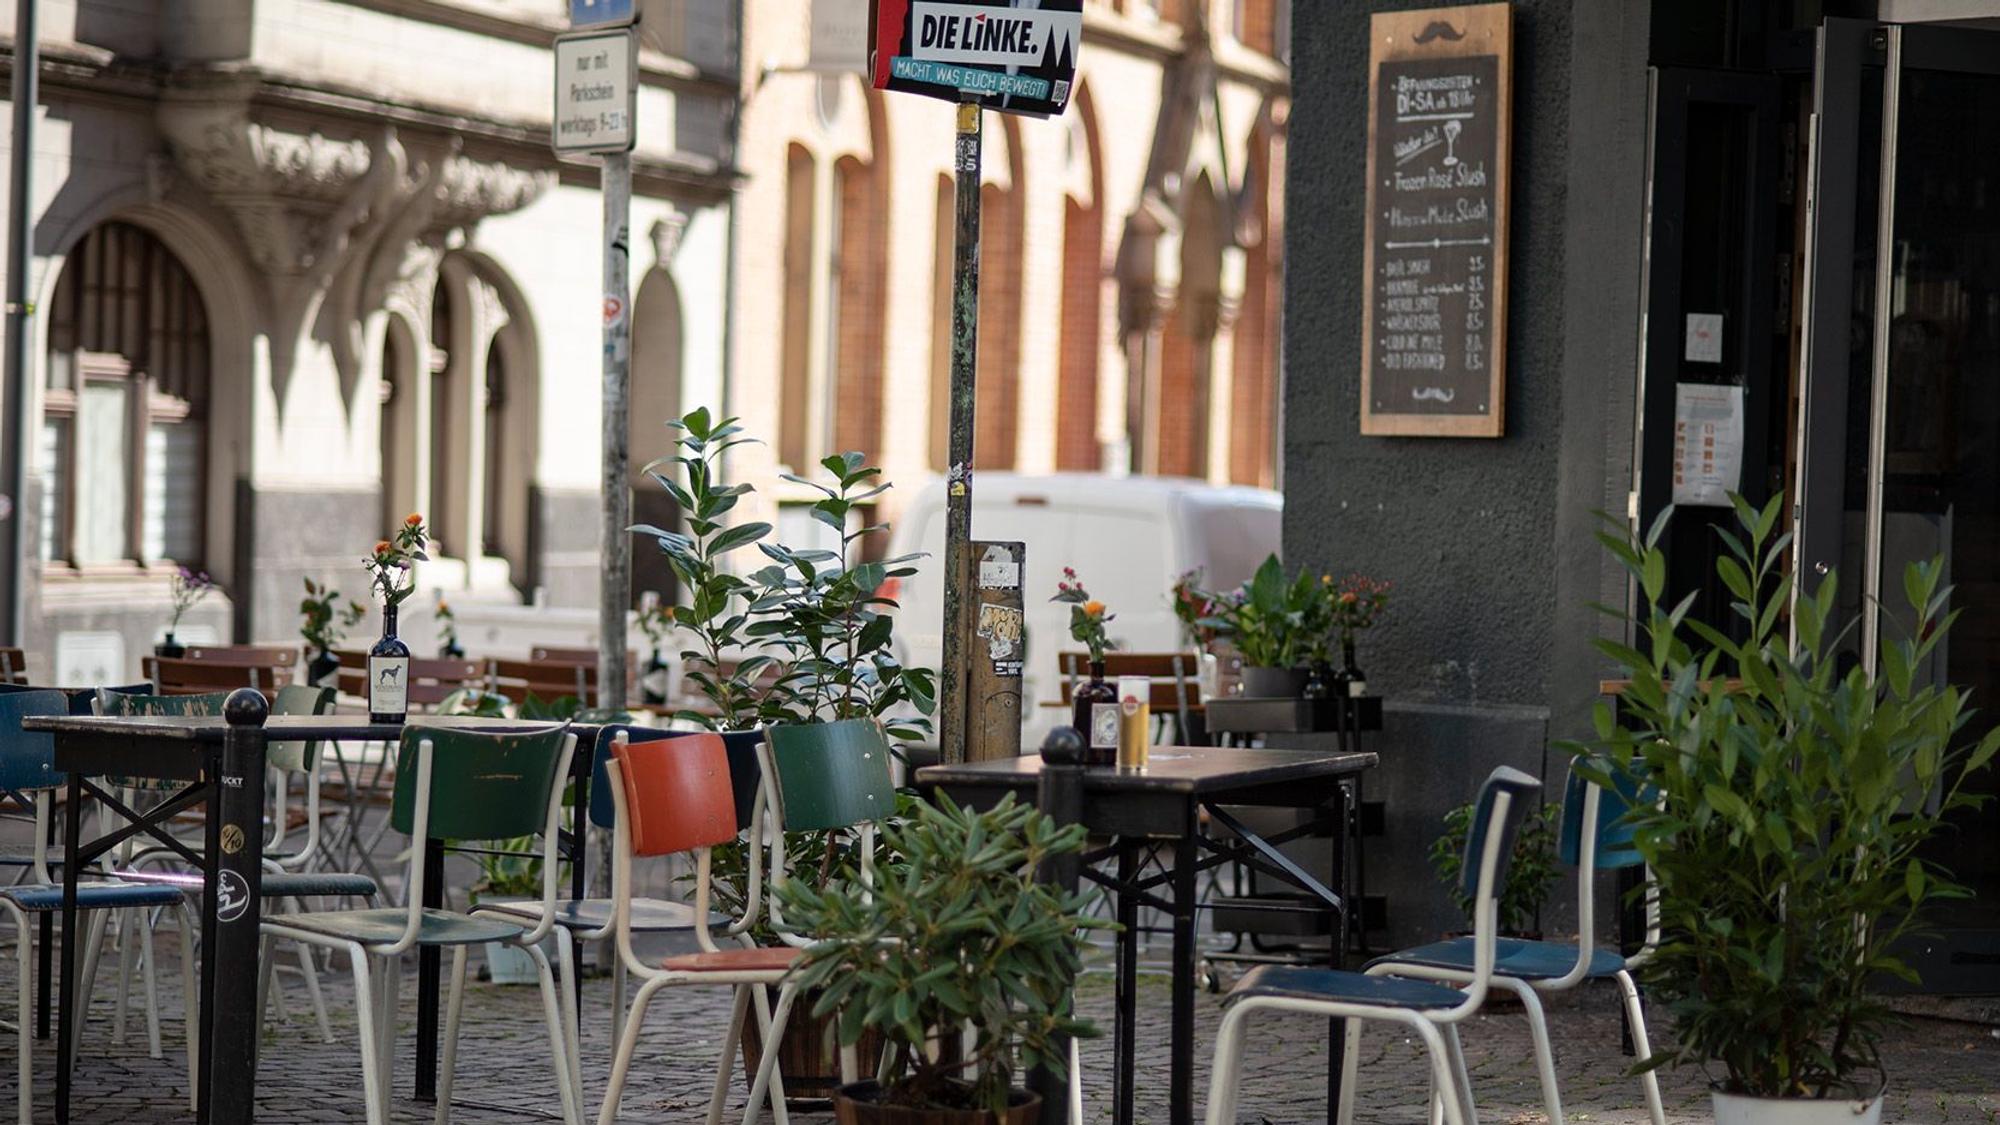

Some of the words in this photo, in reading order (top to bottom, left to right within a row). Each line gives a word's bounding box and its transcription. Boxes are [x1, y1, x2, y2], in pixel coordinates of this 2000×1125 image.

[921, 14, 960, 50] DIE
[936, 68, 960, 85] WAS
[963, 71, 996, 90] EUCH
[1000, 77, 1047, 97] BEWEGT!
